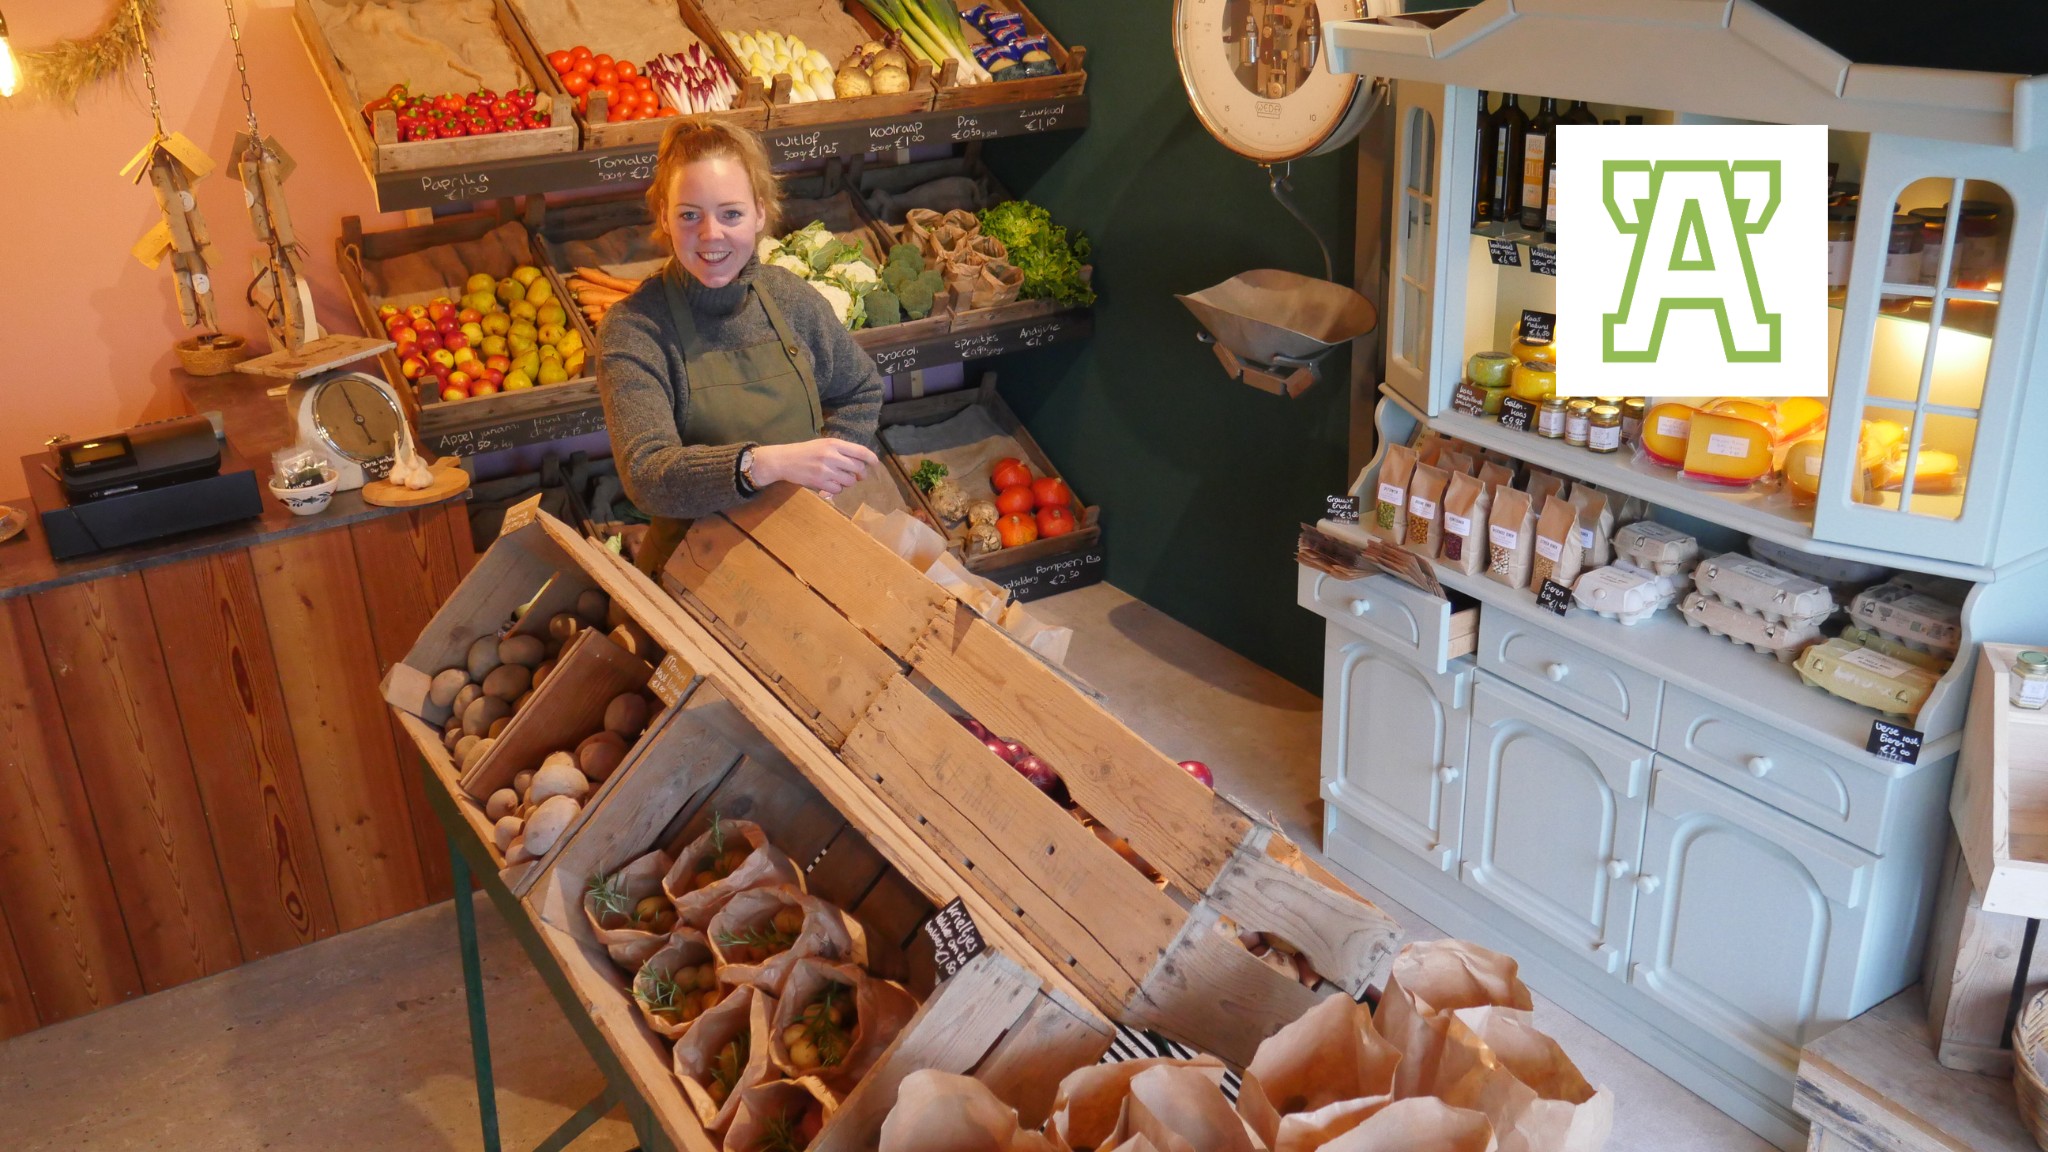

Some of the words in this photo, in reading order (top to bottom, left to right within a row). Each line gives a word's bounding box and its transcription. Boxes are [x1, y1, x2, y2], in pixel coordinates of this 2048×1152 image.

[957, 116, 978, 128] Prei
[1309, 114, 1317, 122] 10
[775, 131, 821, 147] Witlof
[589, 154, 658, 169] Tomaten
[421, 173, 490, 192] Paprika
[439, 431, 474, 449] Appel
